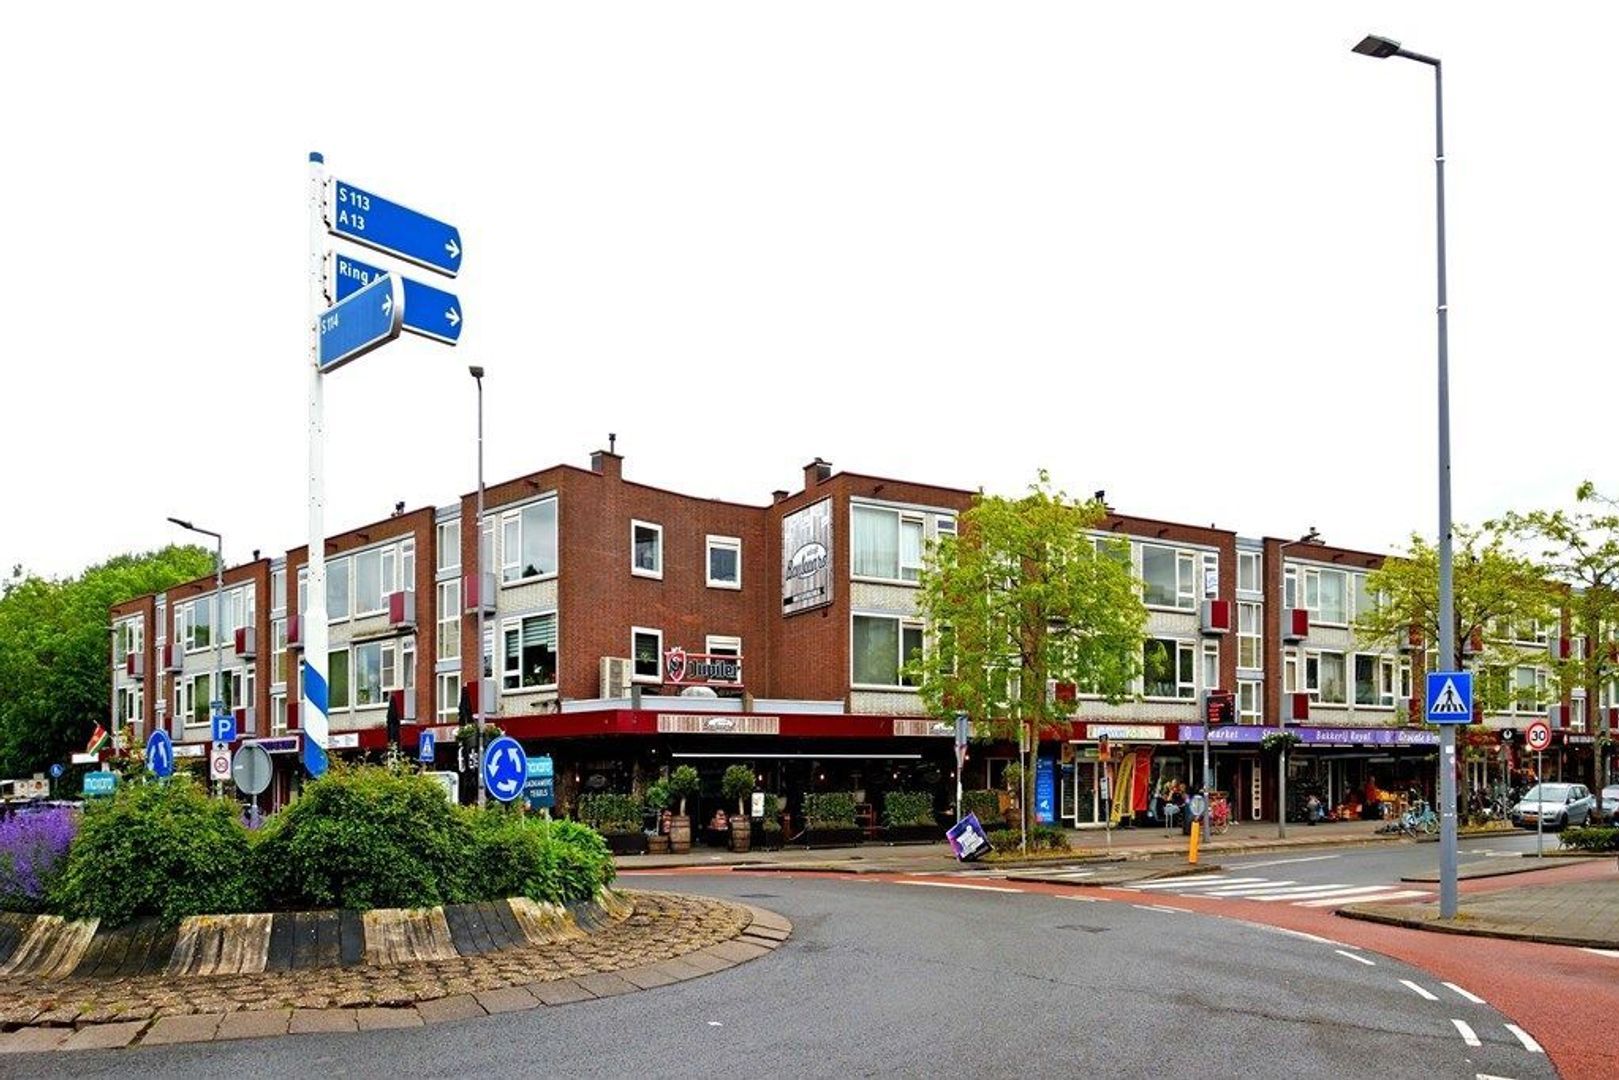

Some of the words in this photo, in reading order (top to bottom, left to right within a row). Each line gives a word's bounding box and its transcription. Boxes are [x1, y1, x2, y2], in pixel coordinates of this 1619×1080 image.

[339, 187, 347, 202] S
[350, 192, 370, 211] 113
[339, 210, 349, 225] A
[351, 214, 365, 231] 13
[339, 260, 369, 286] Ring
[322, 319, 327, 335] S
[327, 312, 339, 332] 114
[687, 659, 742, 679] Jupiler
[218, 719, 231, 739] P
[1316, 730, 1349, 743] Bakkerij
[1350, 731, 1371, 743] Royal
[1532, 730, 1546, 742] 30
